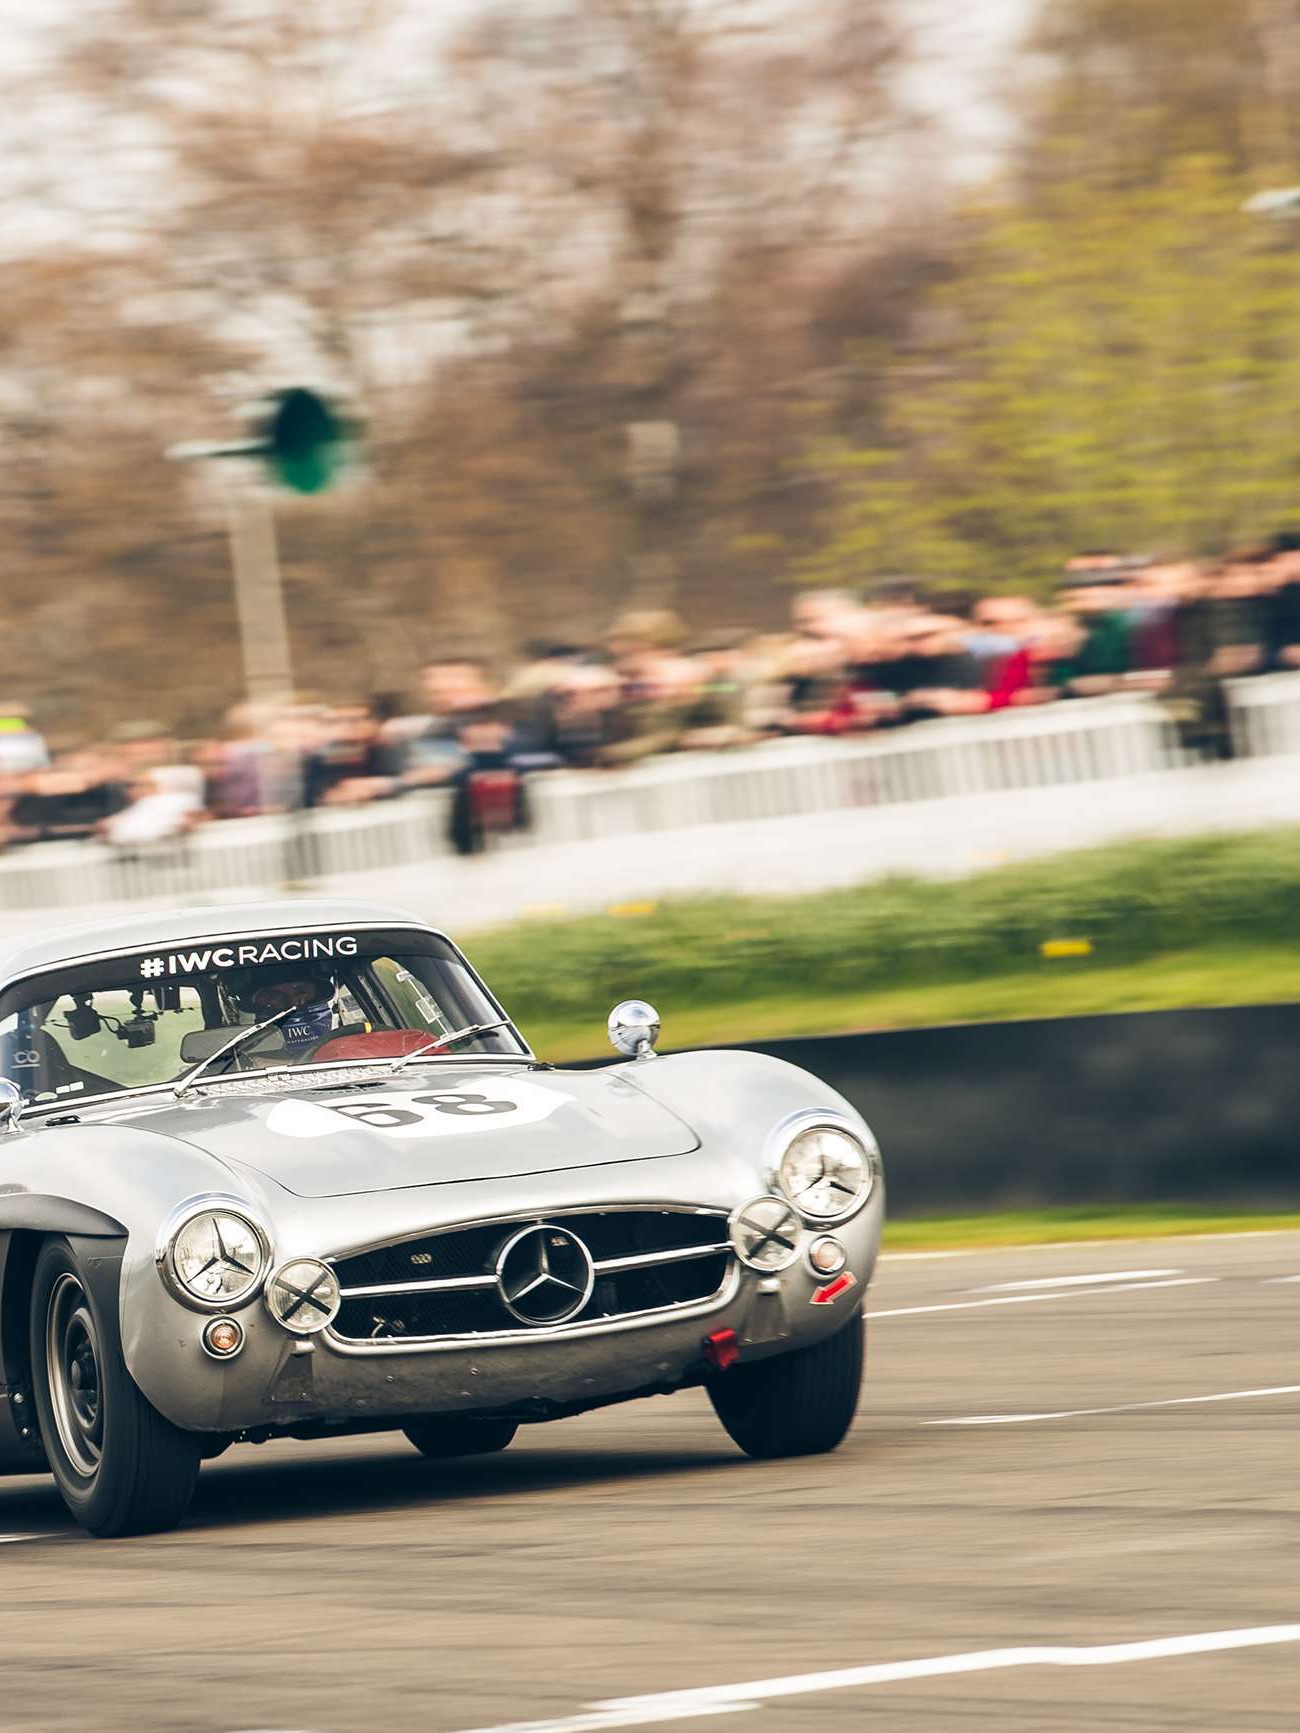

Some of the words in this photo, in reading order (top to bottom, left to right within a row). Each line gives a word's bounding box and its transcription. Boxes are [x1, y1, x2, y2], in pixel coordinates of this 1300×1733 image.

[139, 936, 358, 978] #IWCRACING
[288, 1024, 311, 1038] IWC
[326, 1094, 518, 1128] 68
